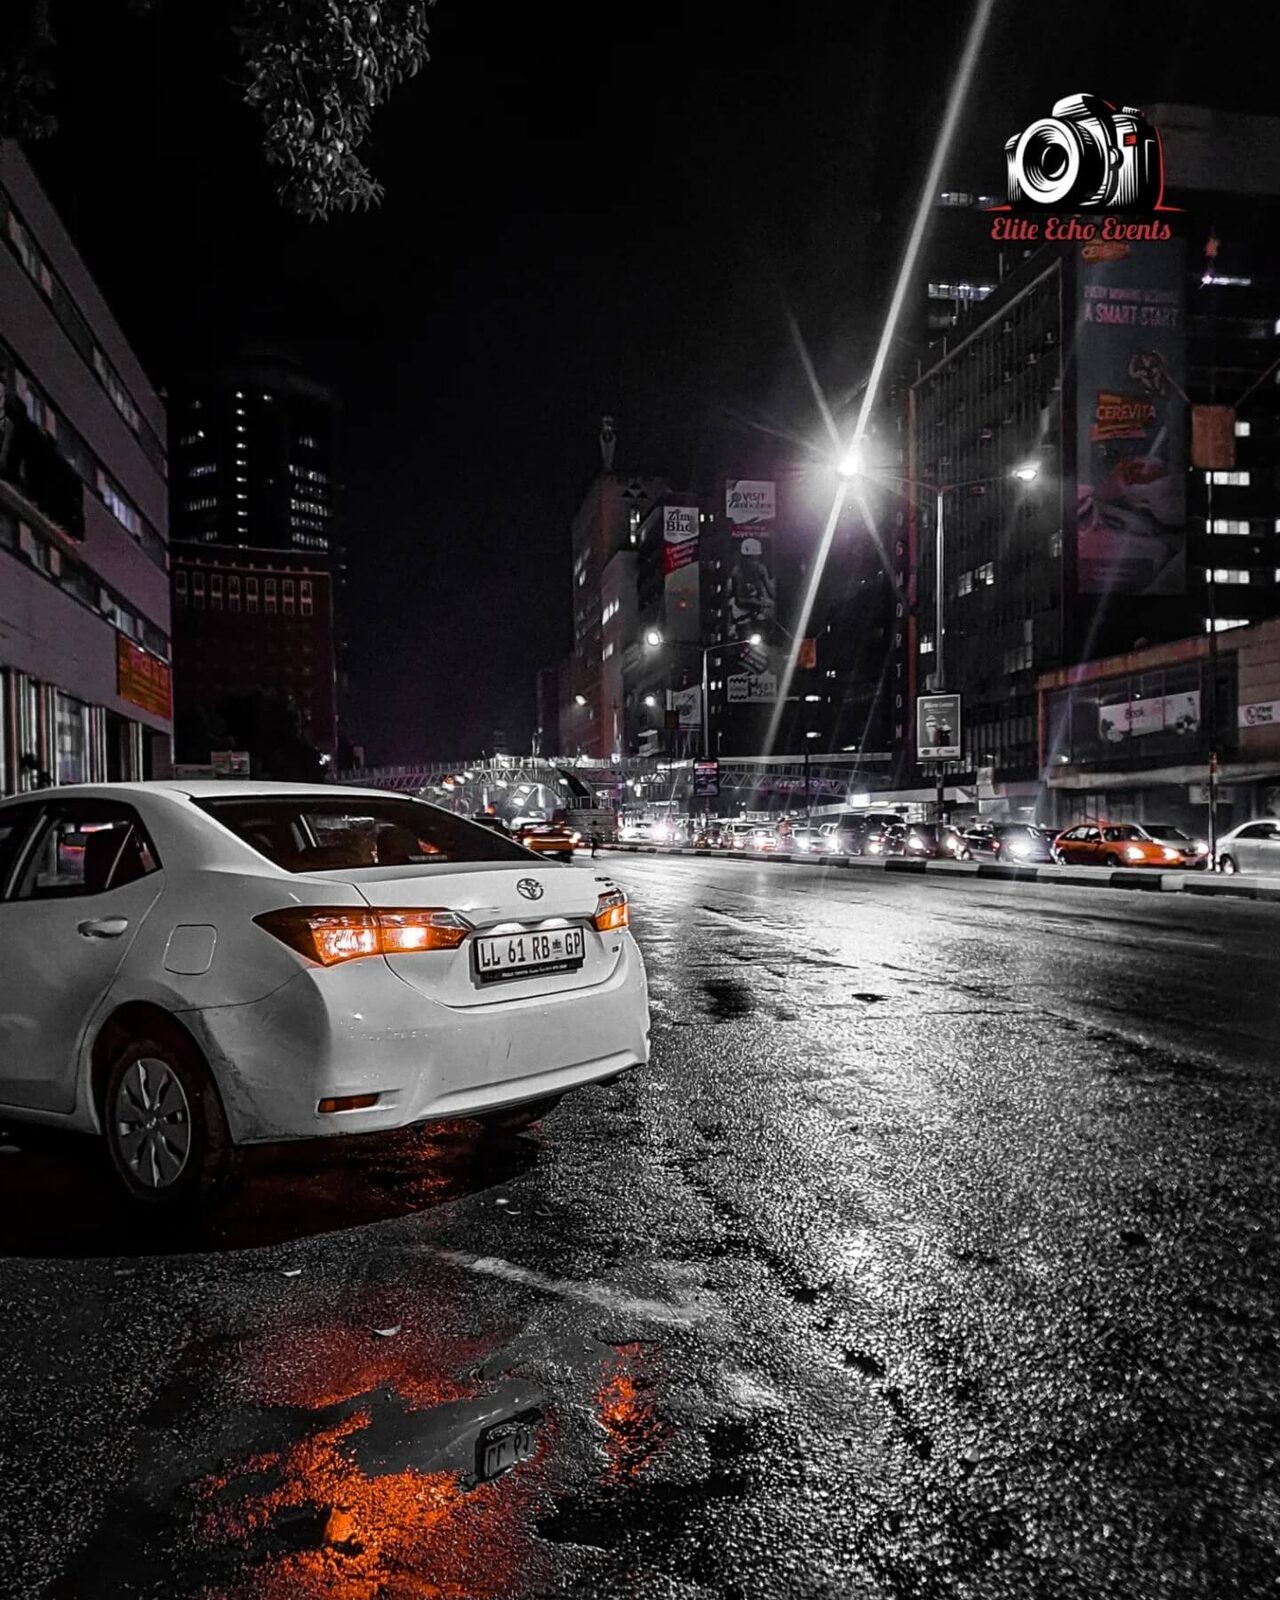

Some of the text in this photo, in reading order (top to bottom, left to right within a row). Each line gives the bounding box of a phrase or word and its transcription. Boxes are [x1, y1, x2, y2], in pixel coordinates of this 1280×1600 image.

[1095, 303, 1138, 325] SMART
[1095, 404, 1156, 421] CEREVITA
[480, 932, 581, 967] LL 61 RB GP
